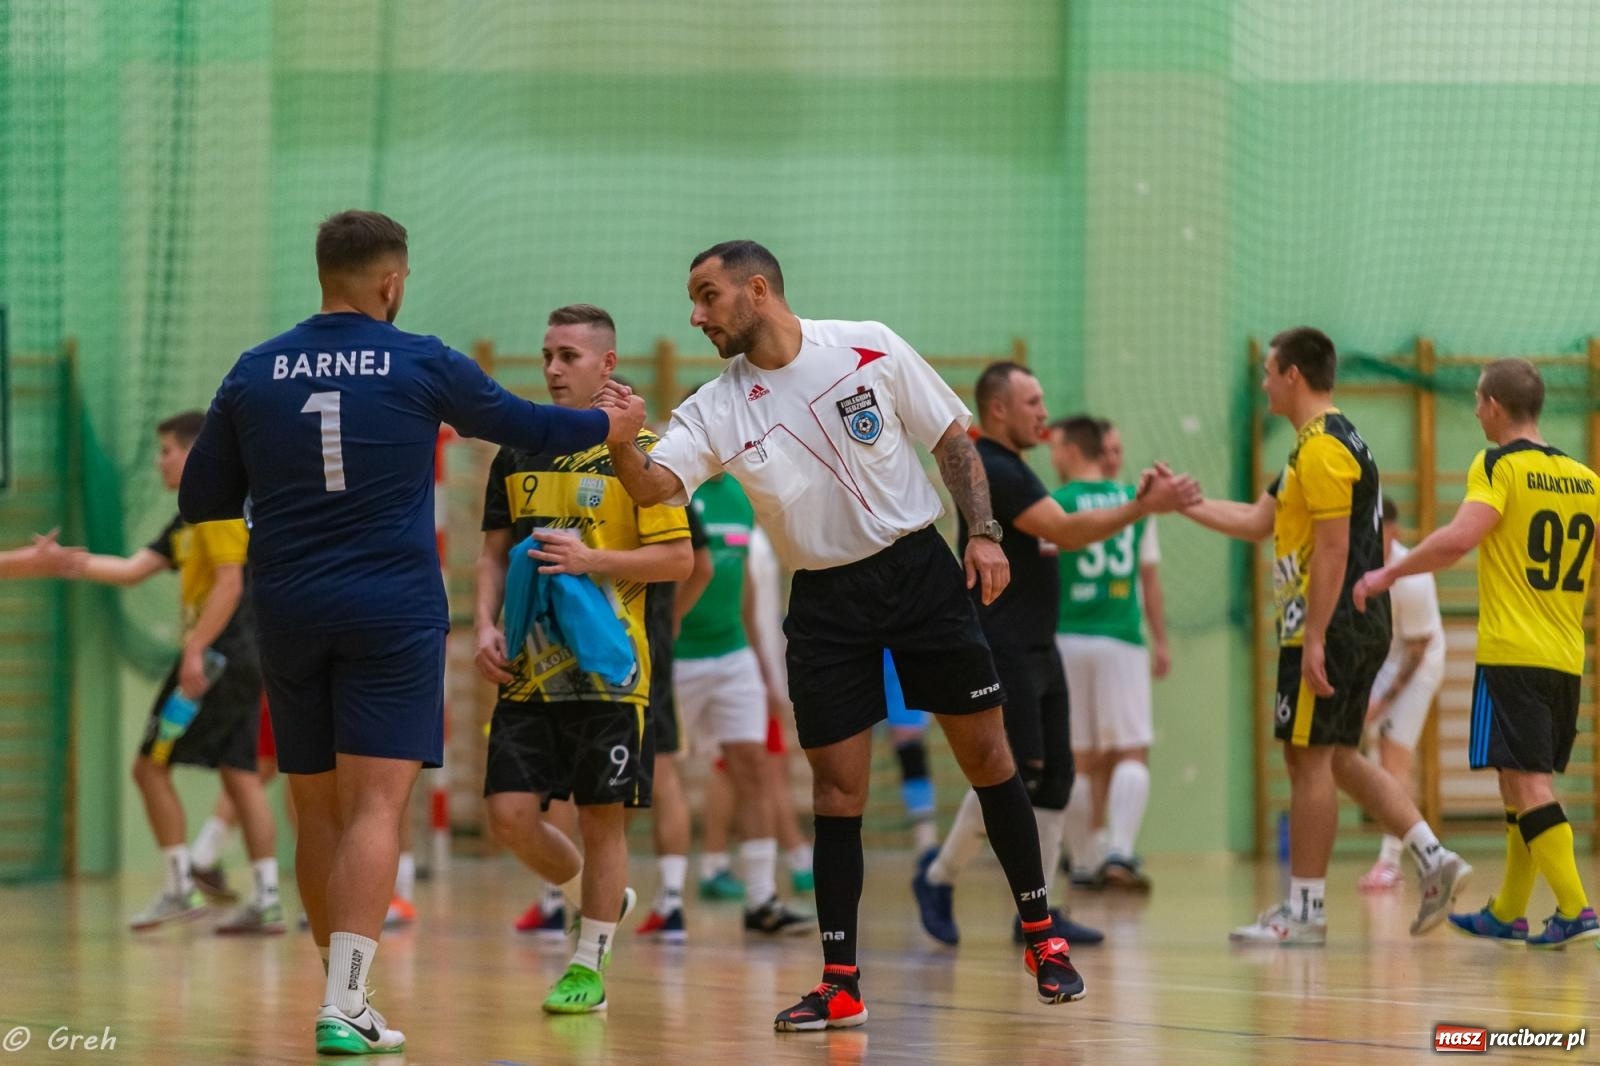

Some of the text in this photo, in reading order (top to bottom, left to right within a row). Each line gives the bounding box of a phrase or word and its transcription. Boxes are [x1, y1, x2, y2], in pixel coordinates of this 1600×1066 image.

[273, 350, 391, 380] BARNEJ
[747, 389, 770, 401] adidas
[300, 390, 346, 492] 1
[522, 474, 539, 507] 9
[1525, 508, 1595, 592] 92
[970, 683, 1000, 699] zina
[610, 744, 629, 777] 9
[1020, 885, 1047, 901] zin
[820, 931, 845, 941] na
